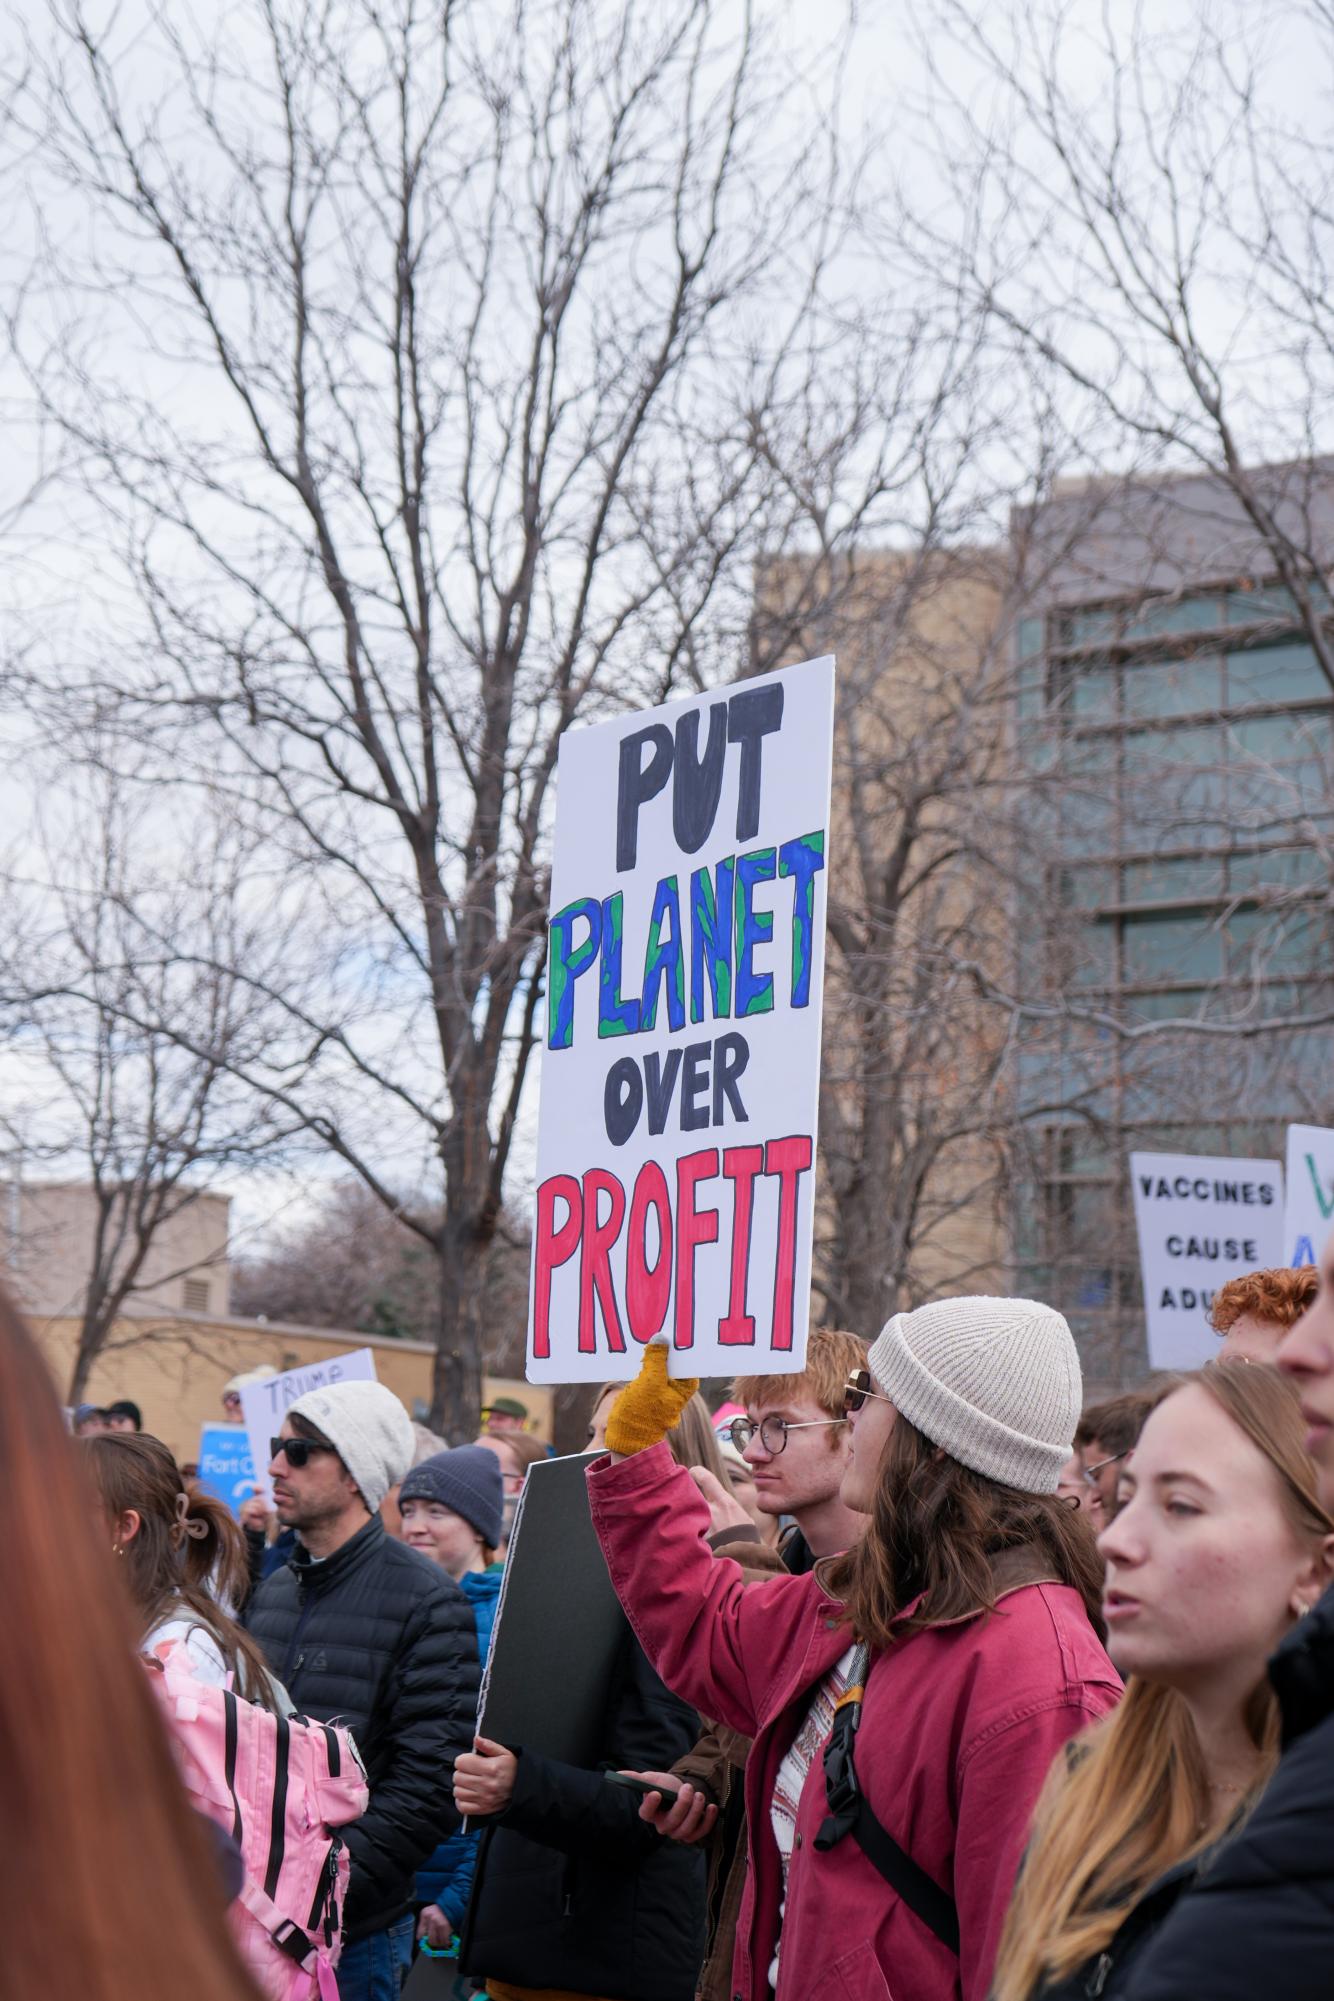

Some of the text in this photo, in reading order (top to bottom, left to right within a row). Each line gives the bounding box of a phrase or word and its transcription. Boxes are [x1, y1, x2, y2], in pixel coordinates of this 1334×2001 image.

[616, 681, 784, 873] PUT
[547, 829, 825, 1051] PLANET
[604, 1031, 749, 1147] OVER
[532, 1134, 813, 1360] PROFIT
[1139, 1174, 1275, 1206] VACCINES
[1165, 1234, 1259, 1262] CAUSE
[1159, 1287, 1217, 1311] ADU
